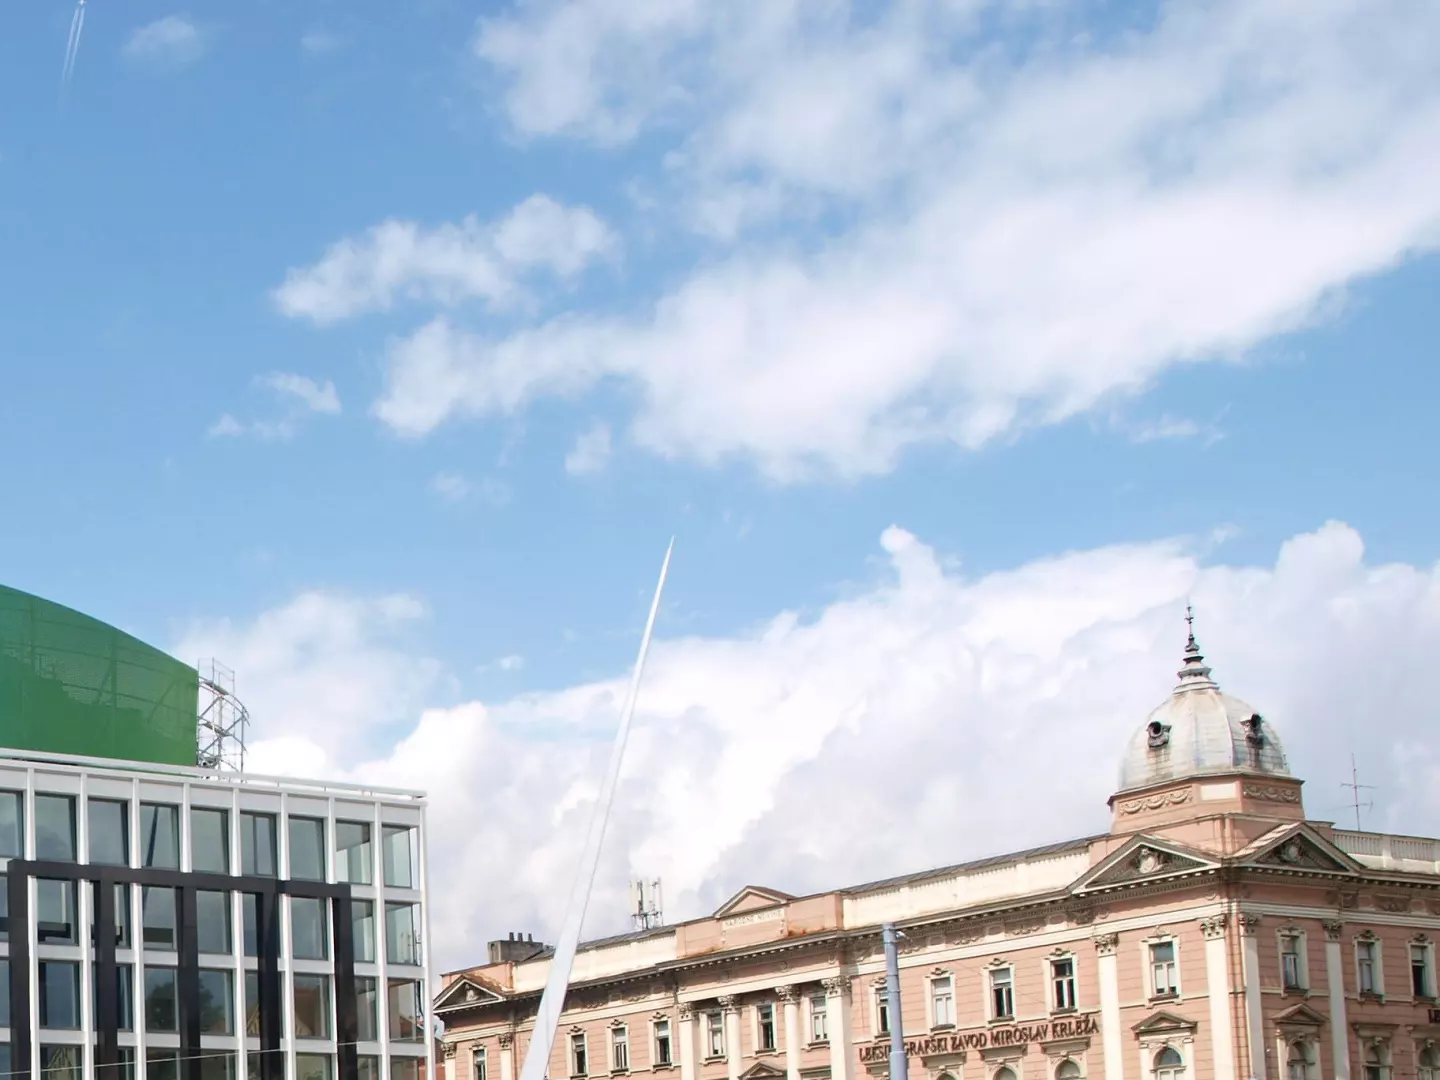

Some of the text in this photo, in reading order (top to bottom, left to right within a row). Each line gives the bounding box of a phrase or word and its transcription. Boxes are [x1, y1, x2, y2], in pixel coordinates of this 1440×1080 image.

[859, 1014, 1100, 1062] LEKSIGRAFSKI ZAVOD MIROSLAV KRLEŽA
